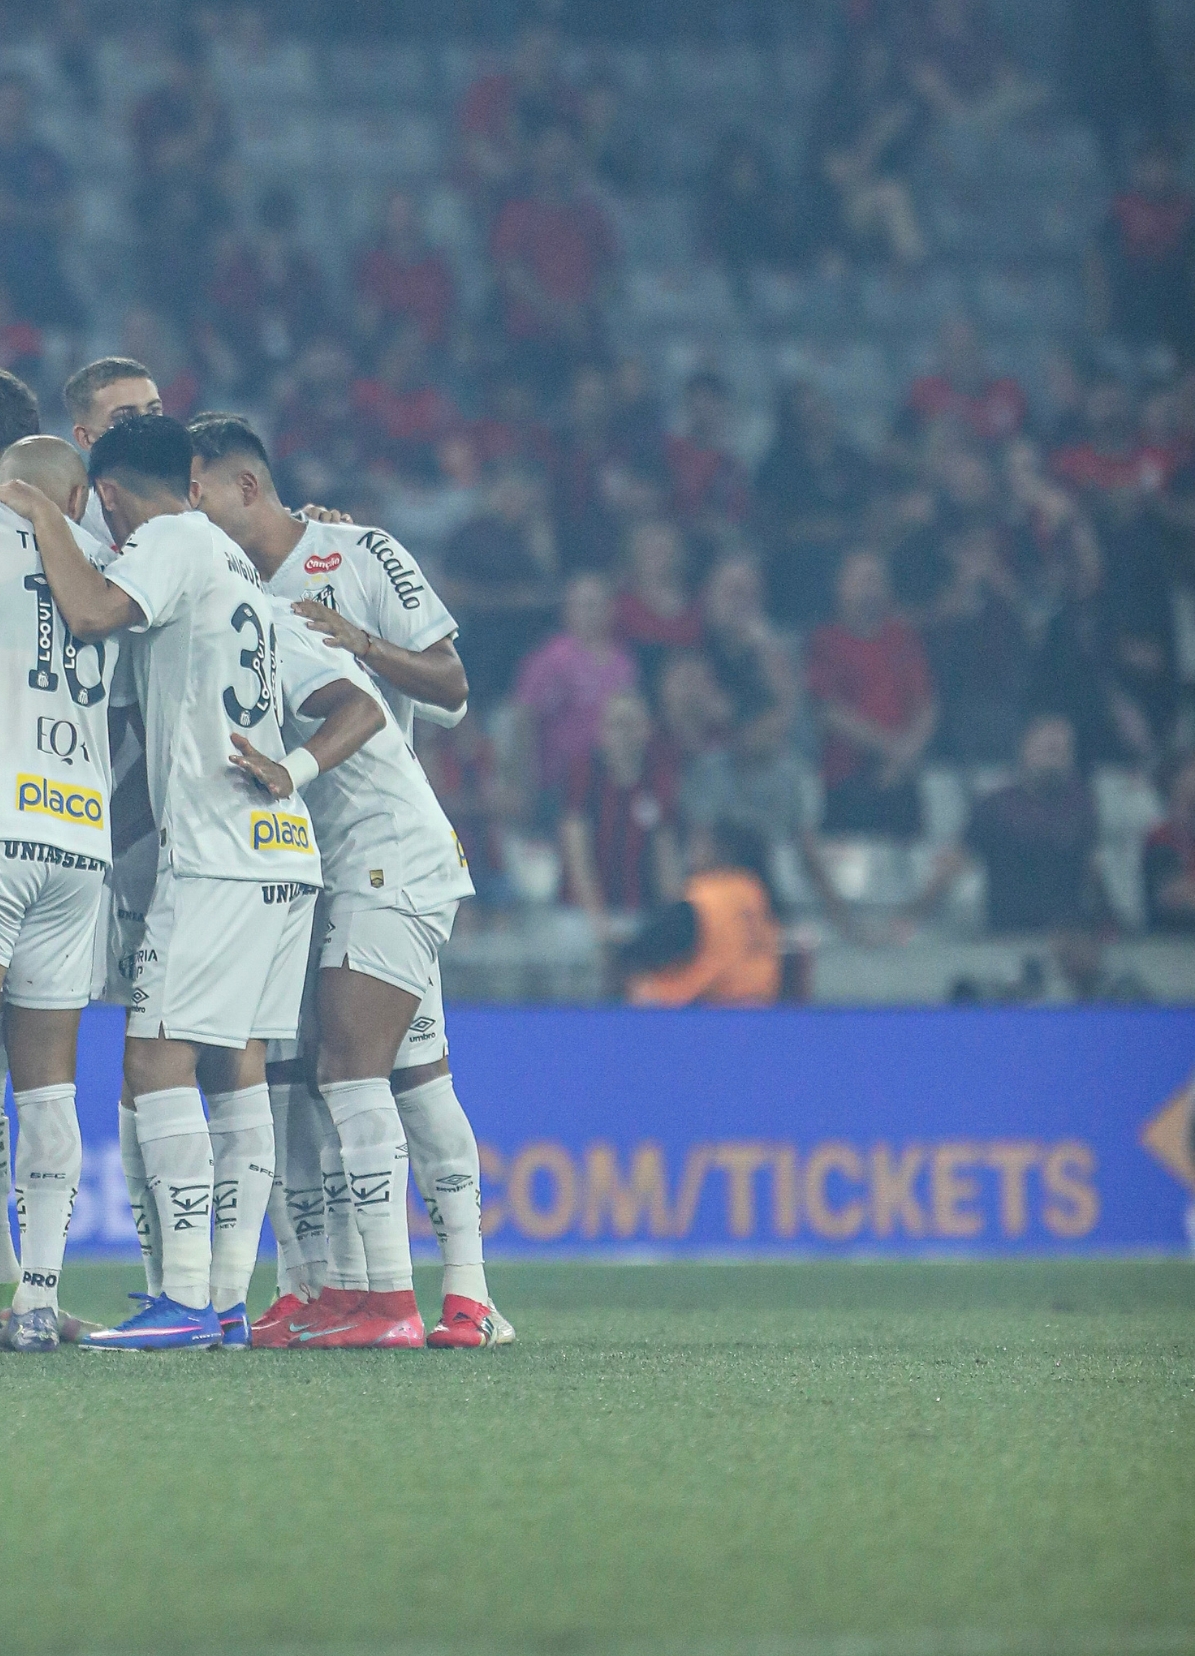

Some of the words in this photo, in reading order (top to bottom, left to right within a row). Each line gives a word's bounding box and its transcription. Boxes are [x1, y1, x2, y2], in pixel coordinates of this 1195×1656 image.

[305, 556, 341, 572] Canção
[356, 529, 425, 610] Kicaldo
[18, 778, 102, 822] placo
[254, 813, 309, 850] placo
[409, 1031, 436, 1043] umbro
[22, 1271, 57, 1288] PRO
